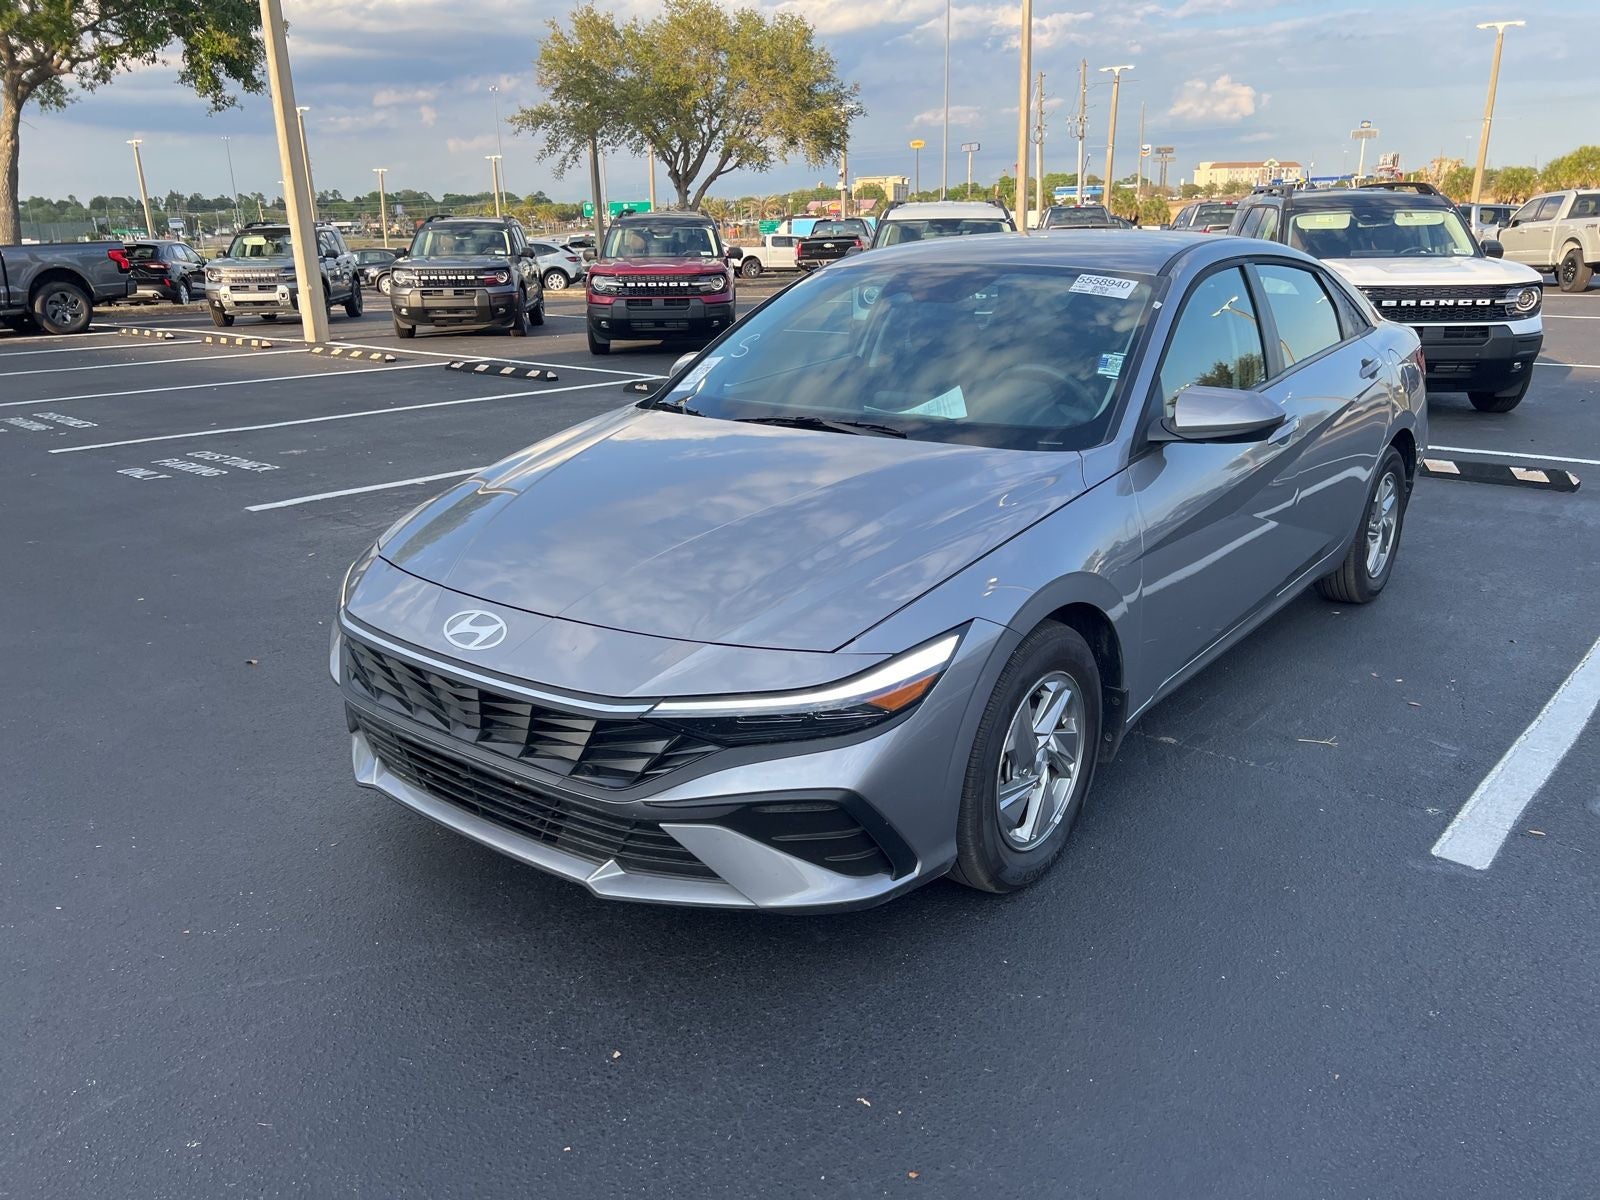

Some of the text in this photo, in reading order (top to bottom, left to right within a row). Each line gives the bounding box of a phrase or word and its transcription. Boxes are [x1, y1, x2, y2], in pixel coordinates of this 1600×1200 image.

[1077, 275, 1131, 289] 5558940
[1381, 299, 1491, 307] BRONCO
[150, 458, 229, 477] PARKING
[186, 450, 280, 473] CUSTOMER
[116, 467, 172, 481] ONLY
